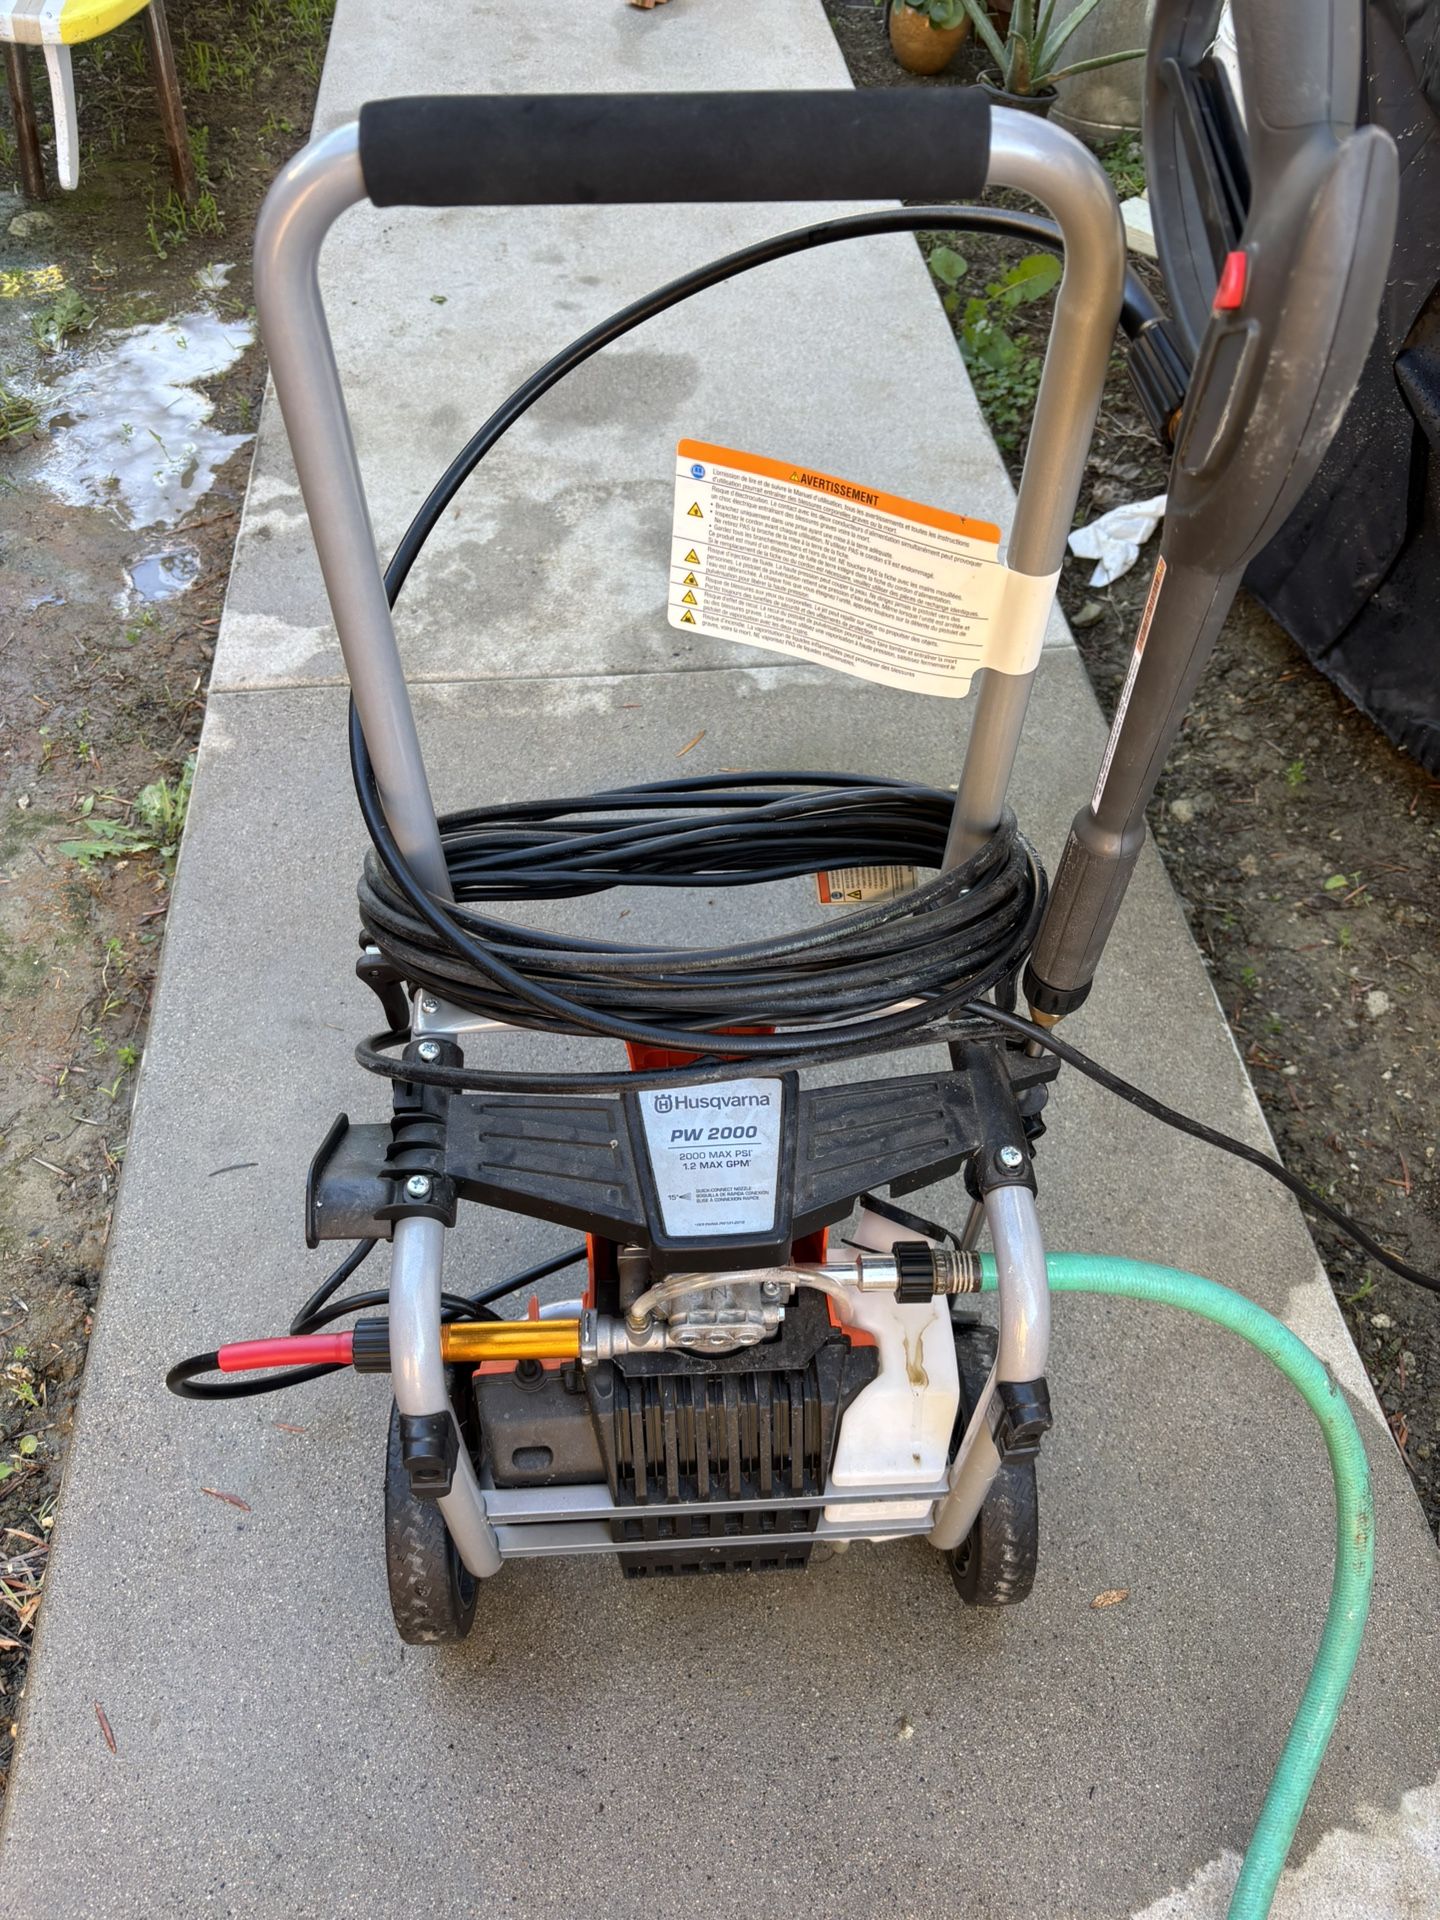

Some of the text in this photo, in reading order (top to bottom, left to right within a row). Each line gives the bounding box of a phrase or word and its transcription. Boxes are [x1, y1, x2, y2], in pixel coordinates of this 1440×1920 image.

[801, 473, 879, 505] AVERTISSEMENT
[844, 504, 855, 512] tous
[771, 516, 783, 524] dans
[818, 513, 830, 522] deux
[848, 546, 858, 554] PAS
[808, 548, 819, 557] hors
[866, 567, 877, 575] PAS
[855, 570, 866, 579] dans
[675, 1094, 770, 1110] Husqvarna
[671, 1126, 757, 1142] PW 2000
[680, 1152, 705, 1160] 2000
[709, 1150, 732, 1159] MAX
[700, 1161, 723, 1169] MAX
